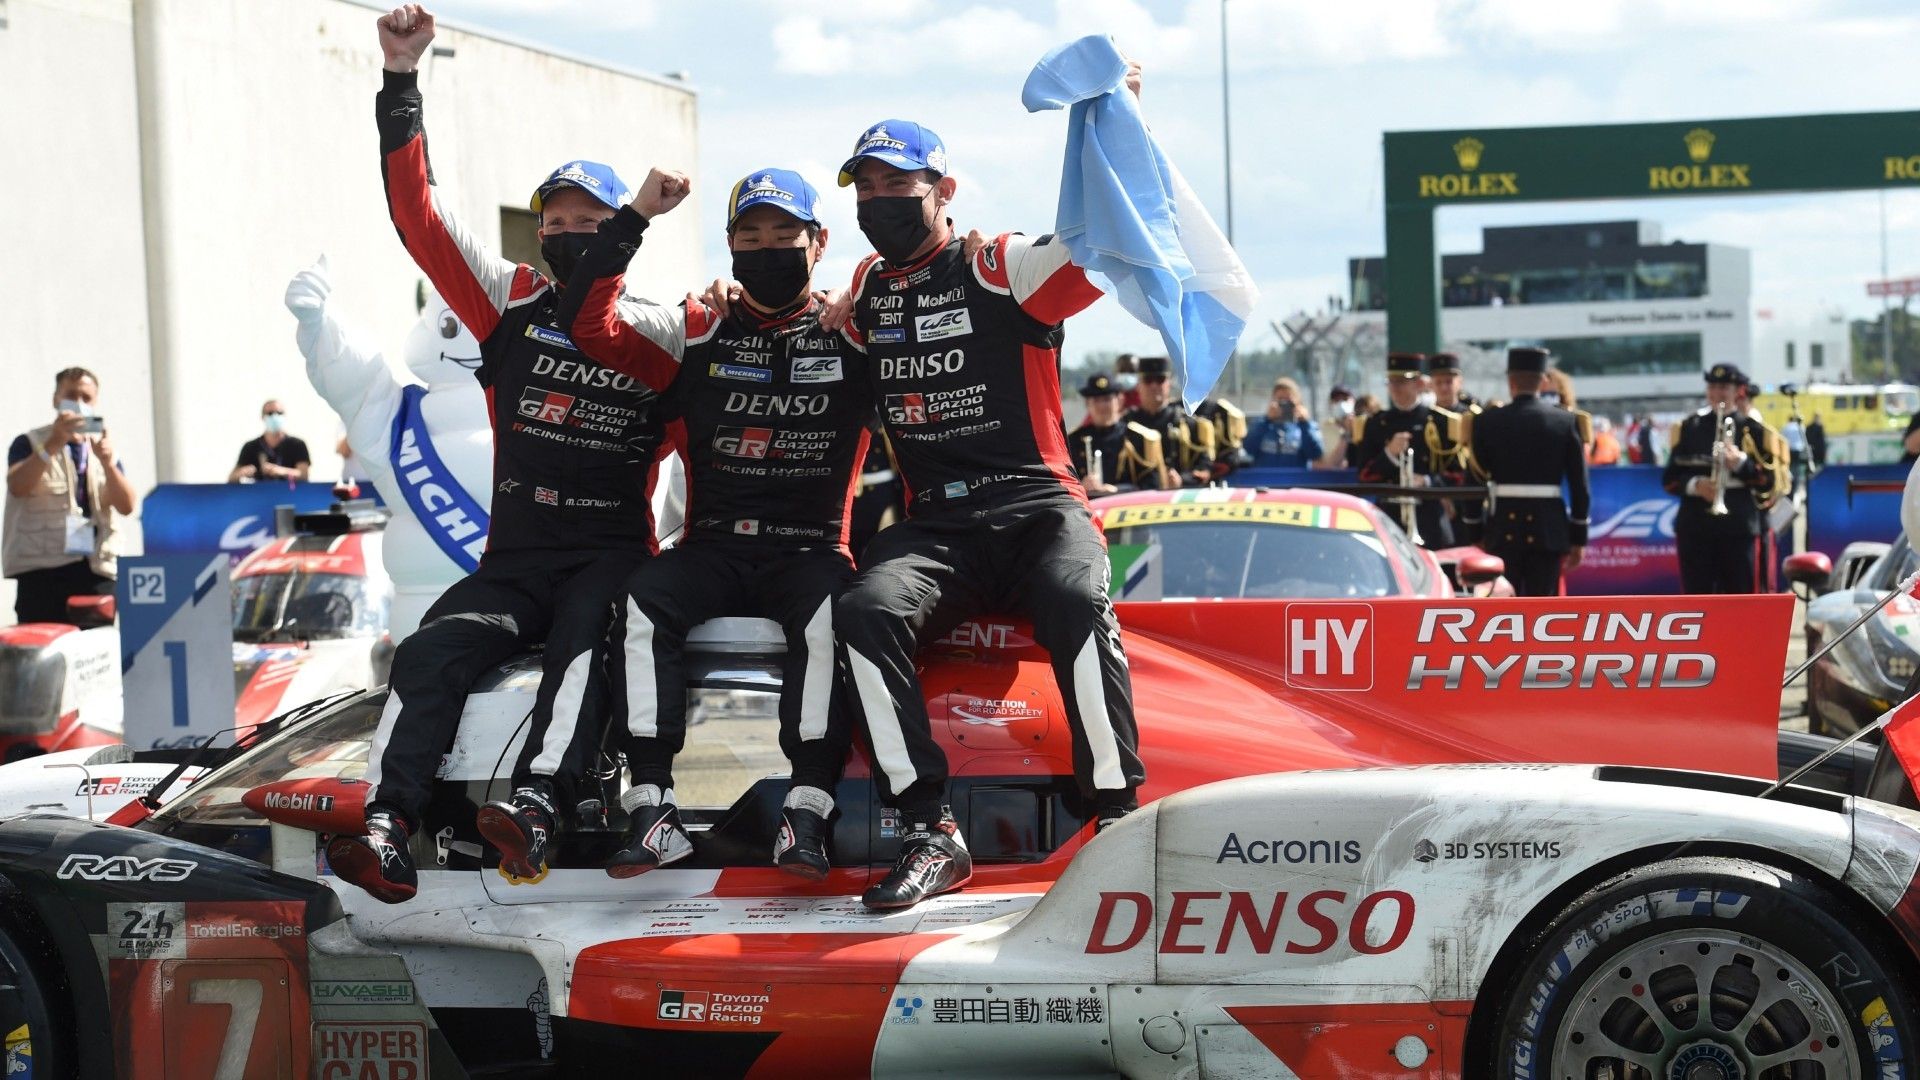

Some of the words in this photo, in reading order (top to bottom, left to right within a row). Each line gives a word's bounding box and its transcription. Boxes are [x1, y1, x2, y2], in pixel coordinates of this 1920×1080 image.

[1419, 173, 1519, 197] ROLEX
[1648, 164, 1751, 189] ROLEX
[738, 188, 793, 205] MICHELIN
[890, 278, 909, 291] GR
[870, 295, 903, 310] AISIN
[918, 290, 952, 308] Mobil
[879, 312, 904, 326] ZENT
[920, 311, 964, 331] WEC
[540, 333, 571, 345] MICHELI
[735, 351, 773, 365] ZENT
[793, 359, 838, 373] WEC
[880, 349, 964, 380] DENSO
[532, 354, 635, 391] DENSO
[727, 369, 766, 379] MICHELIN
[925, 383, 987, 403] TOYOTA
[520, 399, 565, 424] GR
[578, 398, 636, 418] TOYOTA
[724, 391, 830, 416] DENSO
[928, 395, 983, 414] GAZOO
[571, 408, 628, 427] GAZOO
[888, 406, 924, 422] GR
[929, 405, 984, 424] Racing
[568, 417, 624, 437] Racing
[778, 430, 837, 440] TOYOTA
[937, 420, 1001, 442] HYBRID
[512, 422, 566, 442] RACING
[565, 436, 630, 452] HYBRID
[774, 440, 829, 450] GAZOO
[714, 437, 763, 457] GR
[769, 450, 824, 461] Racing
[712, 462, 767, 475] RACING
[770, 467, 832, 477] HYBRID
[576, 499, 621, 508] CONWAY
[1116, 504, 1302, 524] Ferrari
[775, 527, 824, 537] KOBAYASHI
[131, 573, 163, 597] P2
[1416, 607, 1705, 643] RACING
[938, 622, 1015, 648] ENT
[1291, 618, 1368, 675] HY
[1406, 653, 1717, 691] HYBRID
[164, 641, 189, 727] 1
[985, 700, 1027, 708] ACTION
[1009, 708, 1043, 716] SAFETY
[77, 783, 116, 795] GR
[264, 792, 313, 811] Mobil
[1216, 833, 1361, 864] Acronis
[1444, 843, 1468, 859] 3D
[1474, 842, 1561, 859] SYSTEMS
[56, 853, 198, 882] RAYS
[1615, 900, 1662, 924] SPORT
[121, 909, 174, 939] 24h
[191, 922, 302, 939] TotalEnergies
[1084, 890, 1416, 955] DENSO
[135, 940, 171, 948] MANS
[314, 985, 411, 997] HAYASHI
[712, 993, 769, 1003] TOYOTA
[659, 1002, 704, 1021] GR
[711, 1003, 764, 1013] GAZOO
[933, 998, 1103, 1024] 豊田自動織機
[710, 1012, 761, 1025] Racing
[890, 1017, 919, 1025] TOYOTA
[189, 978, 264, 1080] 7
[320, 1031, 418, 1058] HYPER
[322, 1061, 418, 1080] CAR
